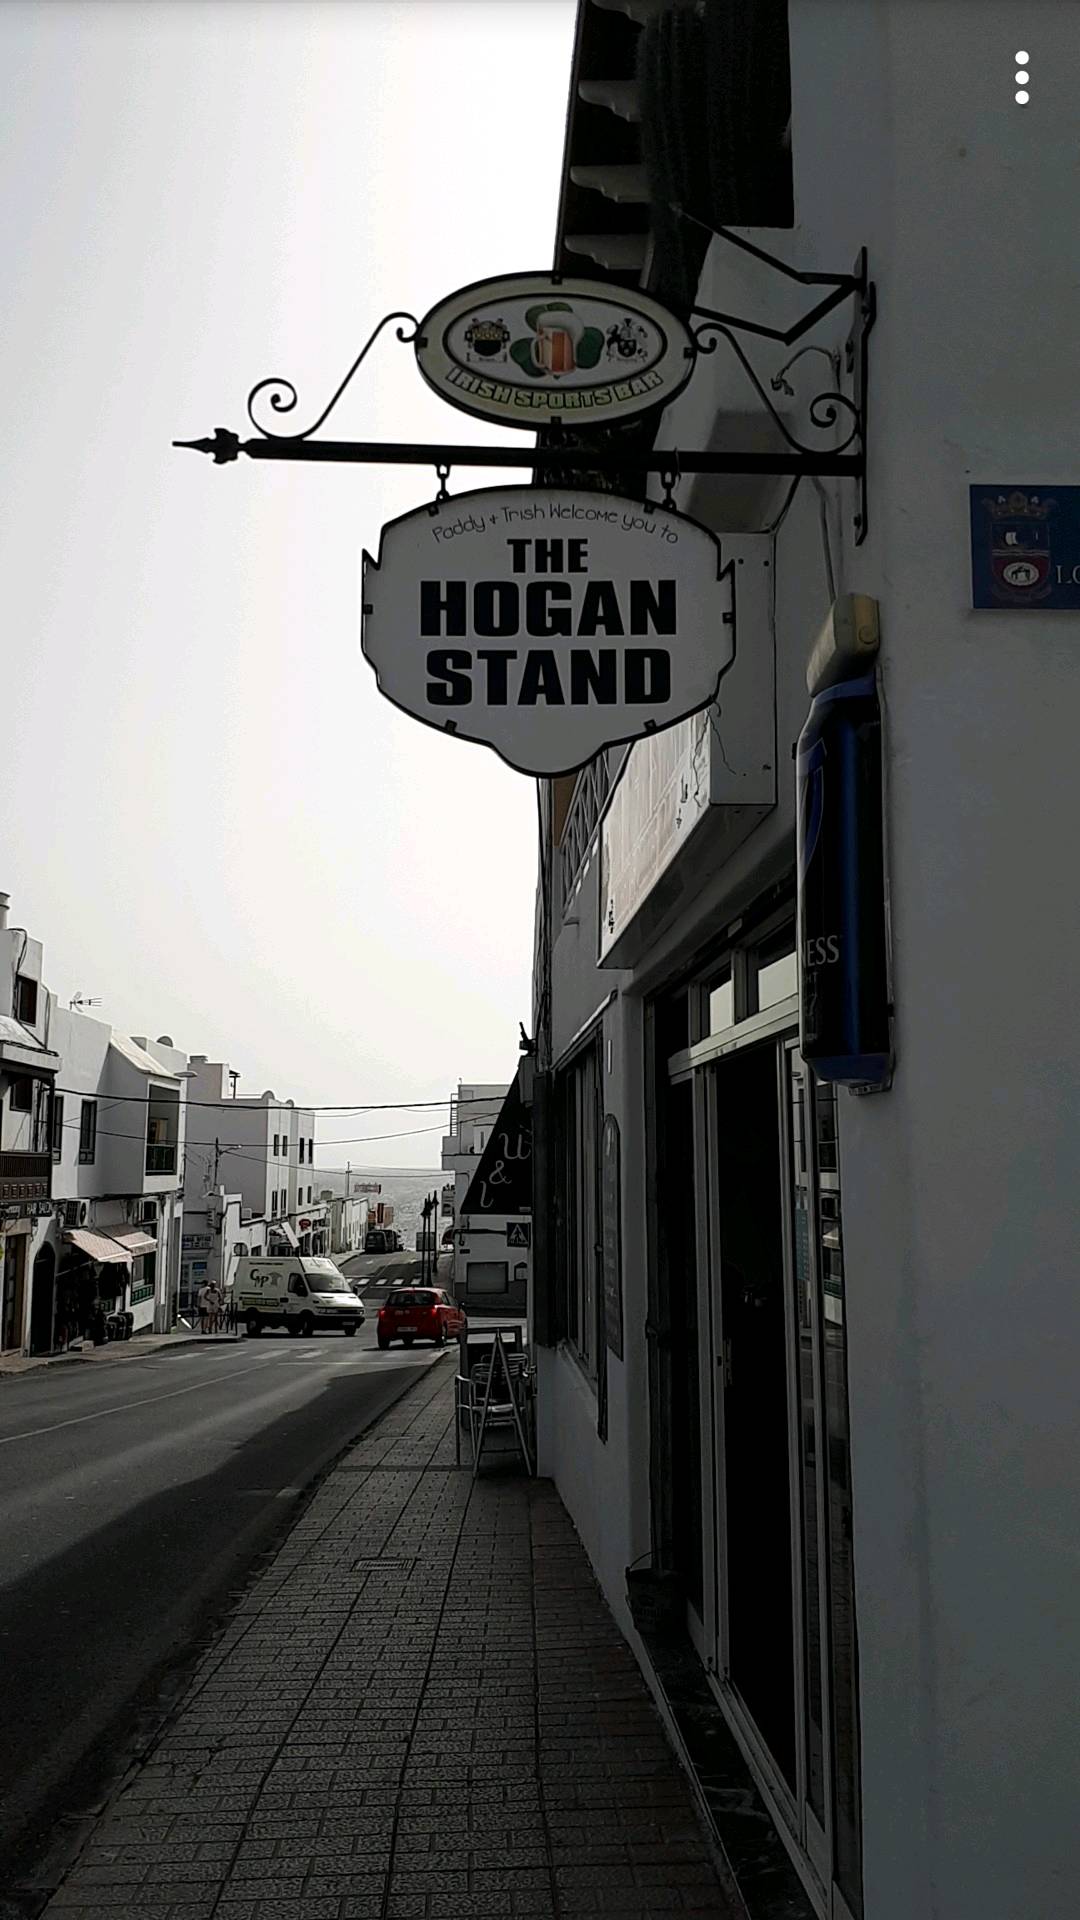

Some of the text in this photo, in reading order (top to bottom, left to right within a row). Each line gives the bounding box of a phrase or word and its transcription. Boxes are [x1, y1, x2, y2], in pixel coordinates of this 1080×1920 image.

[446, 367, 663, 409] IRISH SPORTS BAR
[432, 515, 485, 542] Paddy
[501, 505, 545, 523] Trish
[622, 515, 656, 534] you
[661, 524, 678, 544] to
[507, 539, 589, 574] THE
[421, 579, 677, 637] HOGAN
[426, 648, 671, 706] STAND
